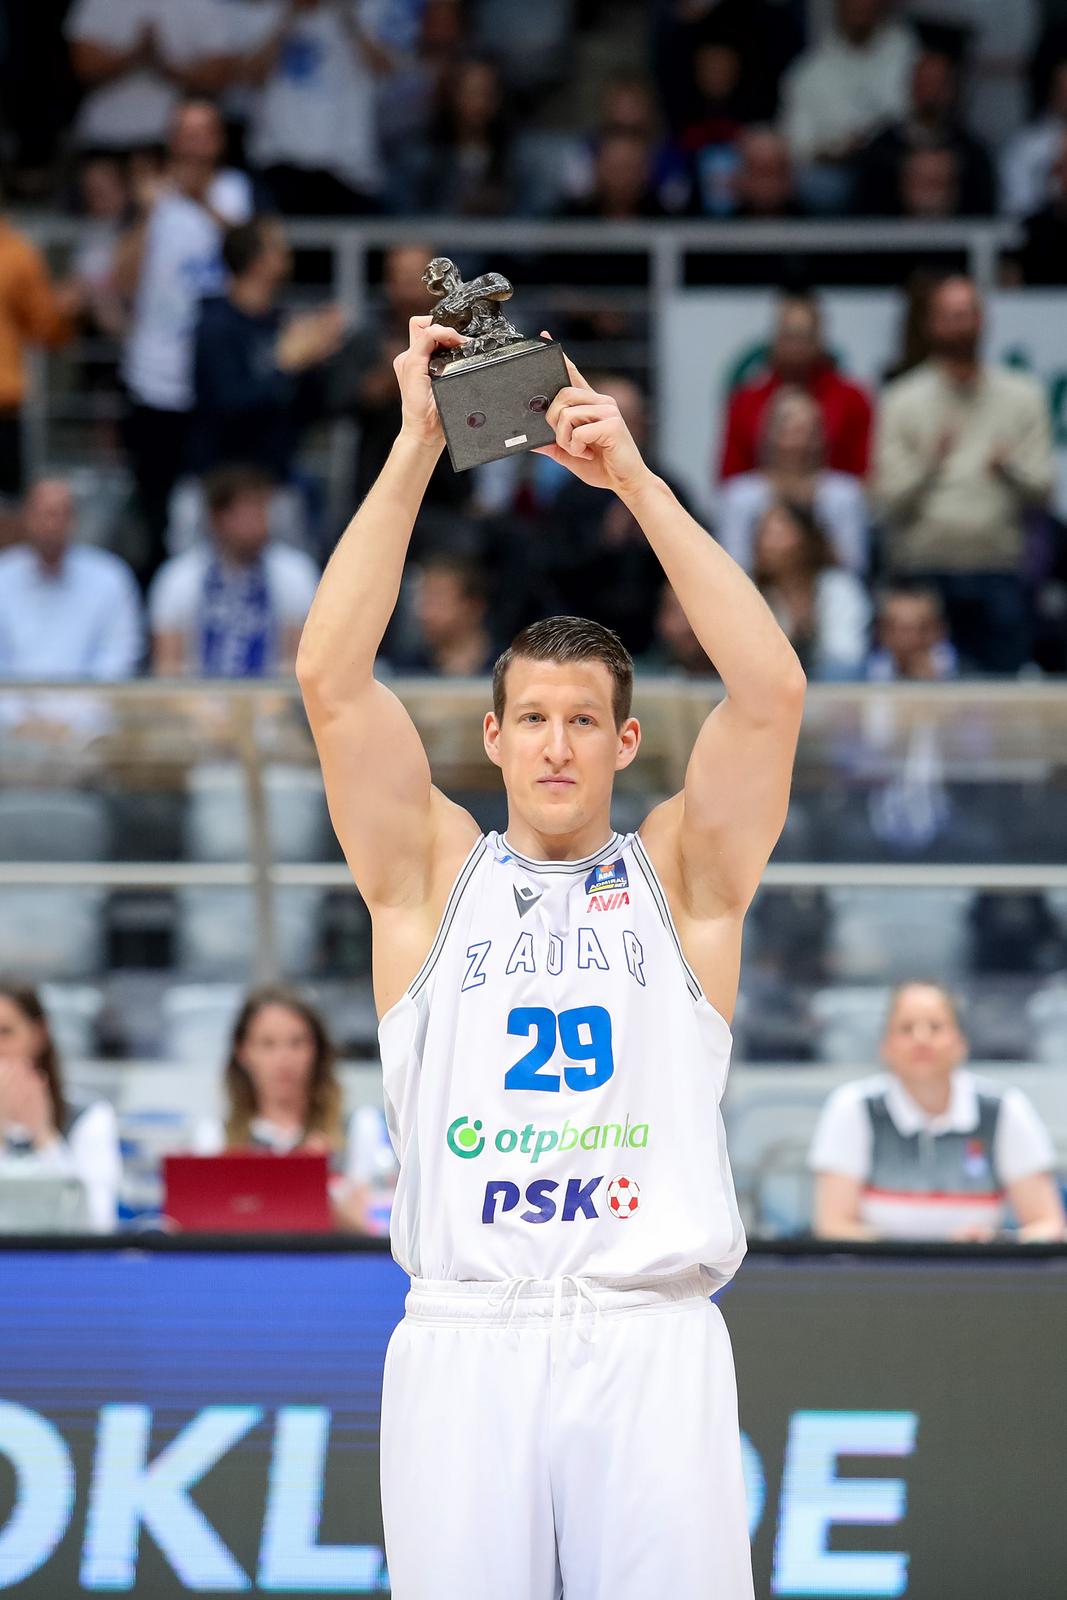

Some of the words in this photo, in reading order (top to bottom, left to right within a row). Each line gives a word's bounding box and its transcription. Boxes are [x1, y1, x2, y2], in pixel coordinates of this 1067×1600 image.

[586, 891, 630, 913] AVIA
[590, 877, 626, 889] ADMIRAL
[461, 927, 646, 992] ZADAR
[504, 1005, 614, 1093] 29
[481, 1175, 605, 1225] PSK
